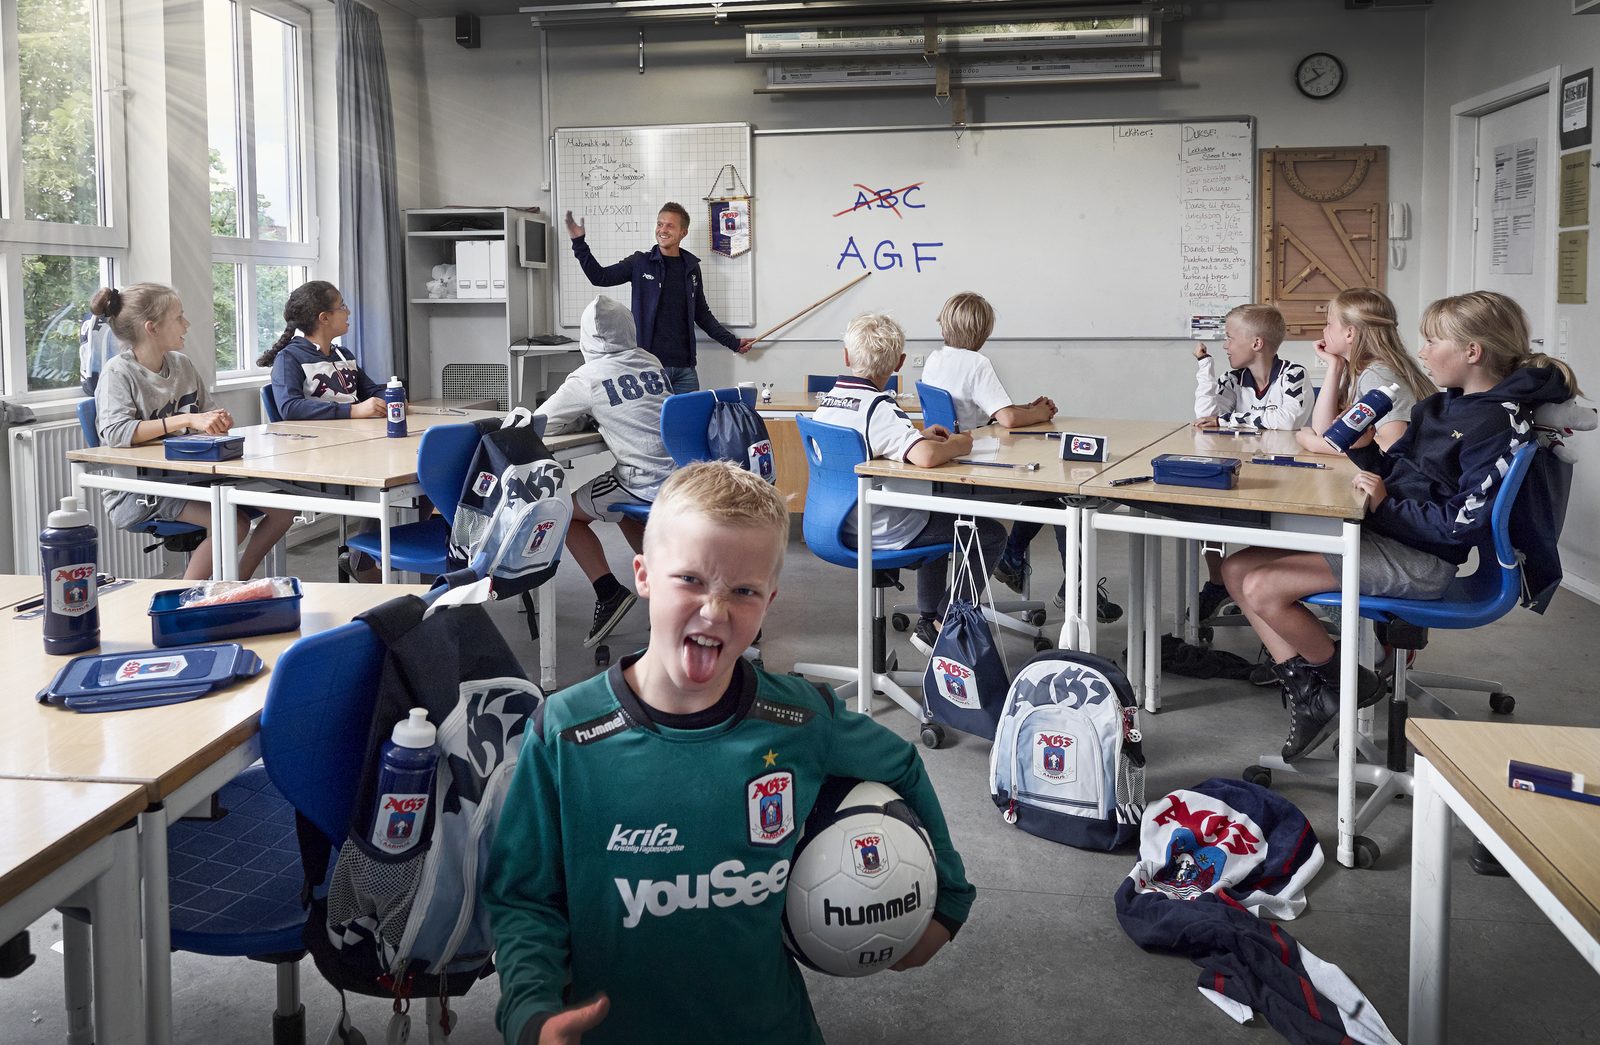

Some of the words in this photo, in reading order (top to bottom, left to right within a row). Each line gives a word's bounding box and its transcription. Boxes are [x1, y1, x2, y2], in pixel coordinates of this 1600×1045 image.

[853, 186, 925, 211] ABC
[837, 236, 943, 272] AGF
[937, 658, 971, 679] AGF
[575, 712, 626, 743] hummel
[1037, 733, 1074, 748] AGF
[752, 776, 790, 800] AGF
[384, 796, 426, 814] AGF
[606, 823, 678, 850] krifa
[614, 858, 790, 929] youSee
[824, 881, 921, 927] hummel
